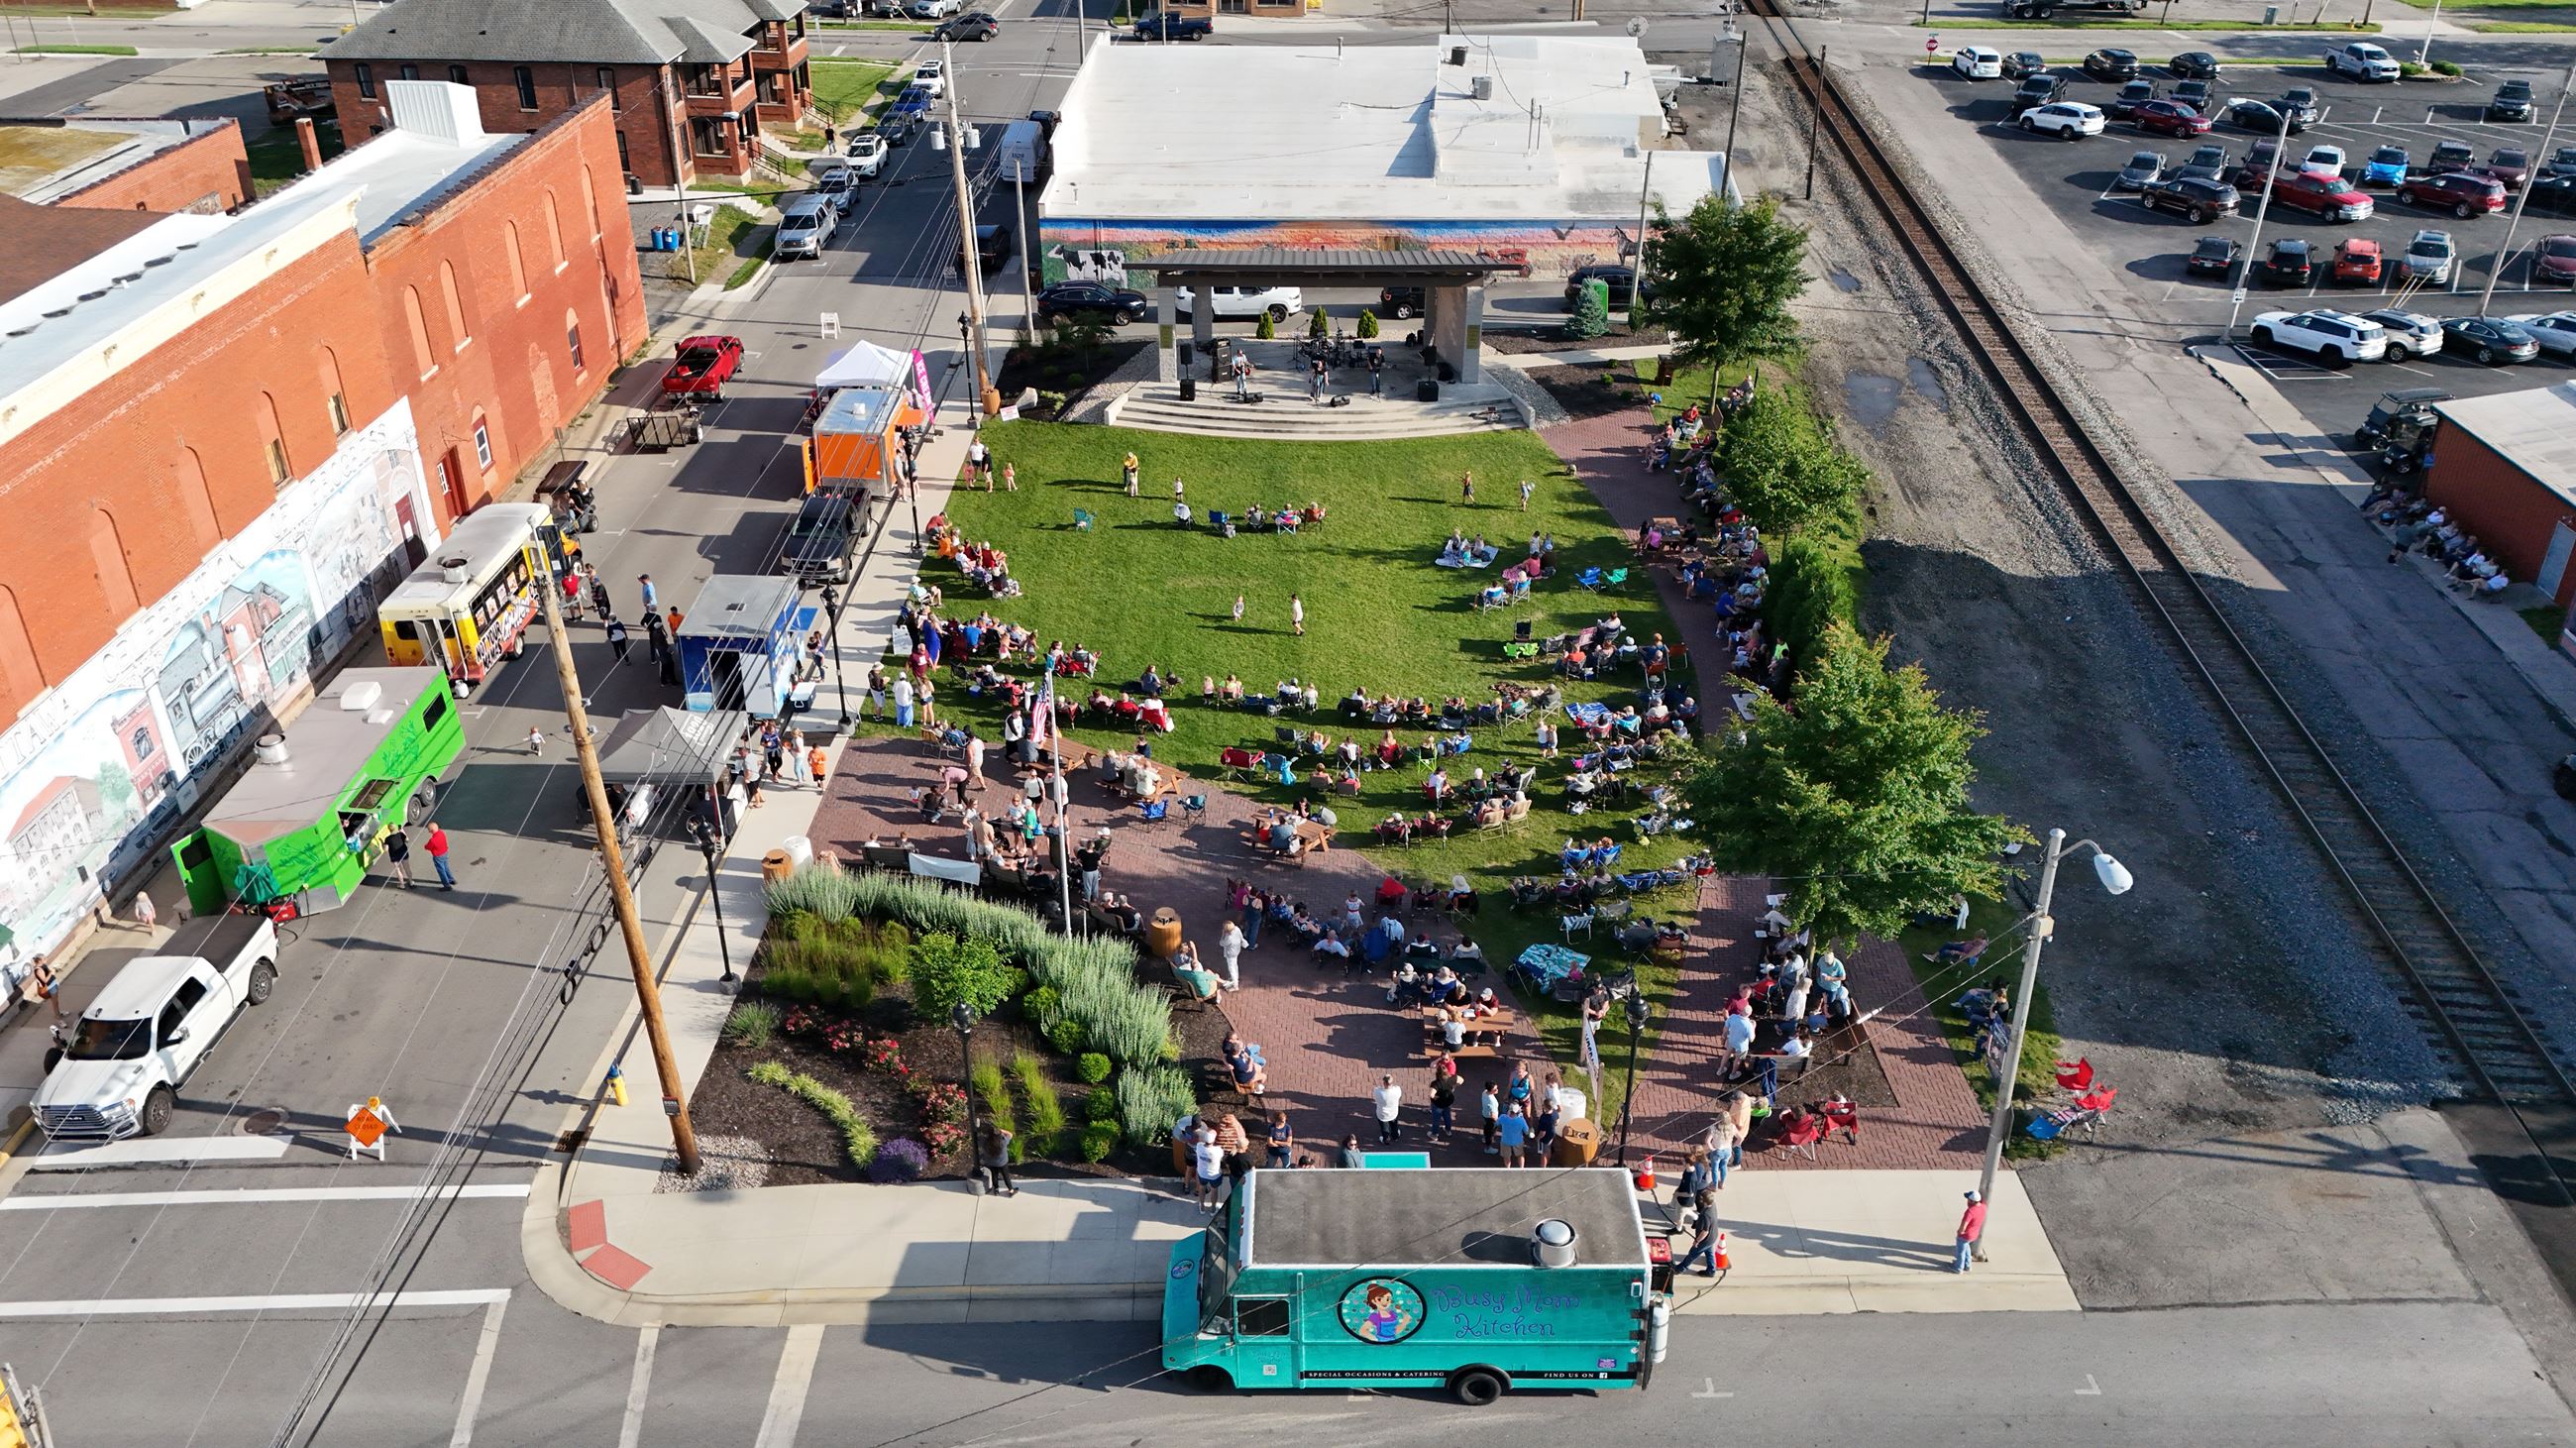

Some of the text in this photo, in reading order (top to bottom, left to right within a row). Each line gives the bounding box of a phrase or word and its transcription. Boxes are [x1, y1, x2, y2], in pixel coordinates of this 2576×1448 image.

[915, 359, 932, 406] ICE CREAM
[1431, 1284, 1579, 1313] Busy Mom
[1453, 1312, 1555, 1338] Kitchen
